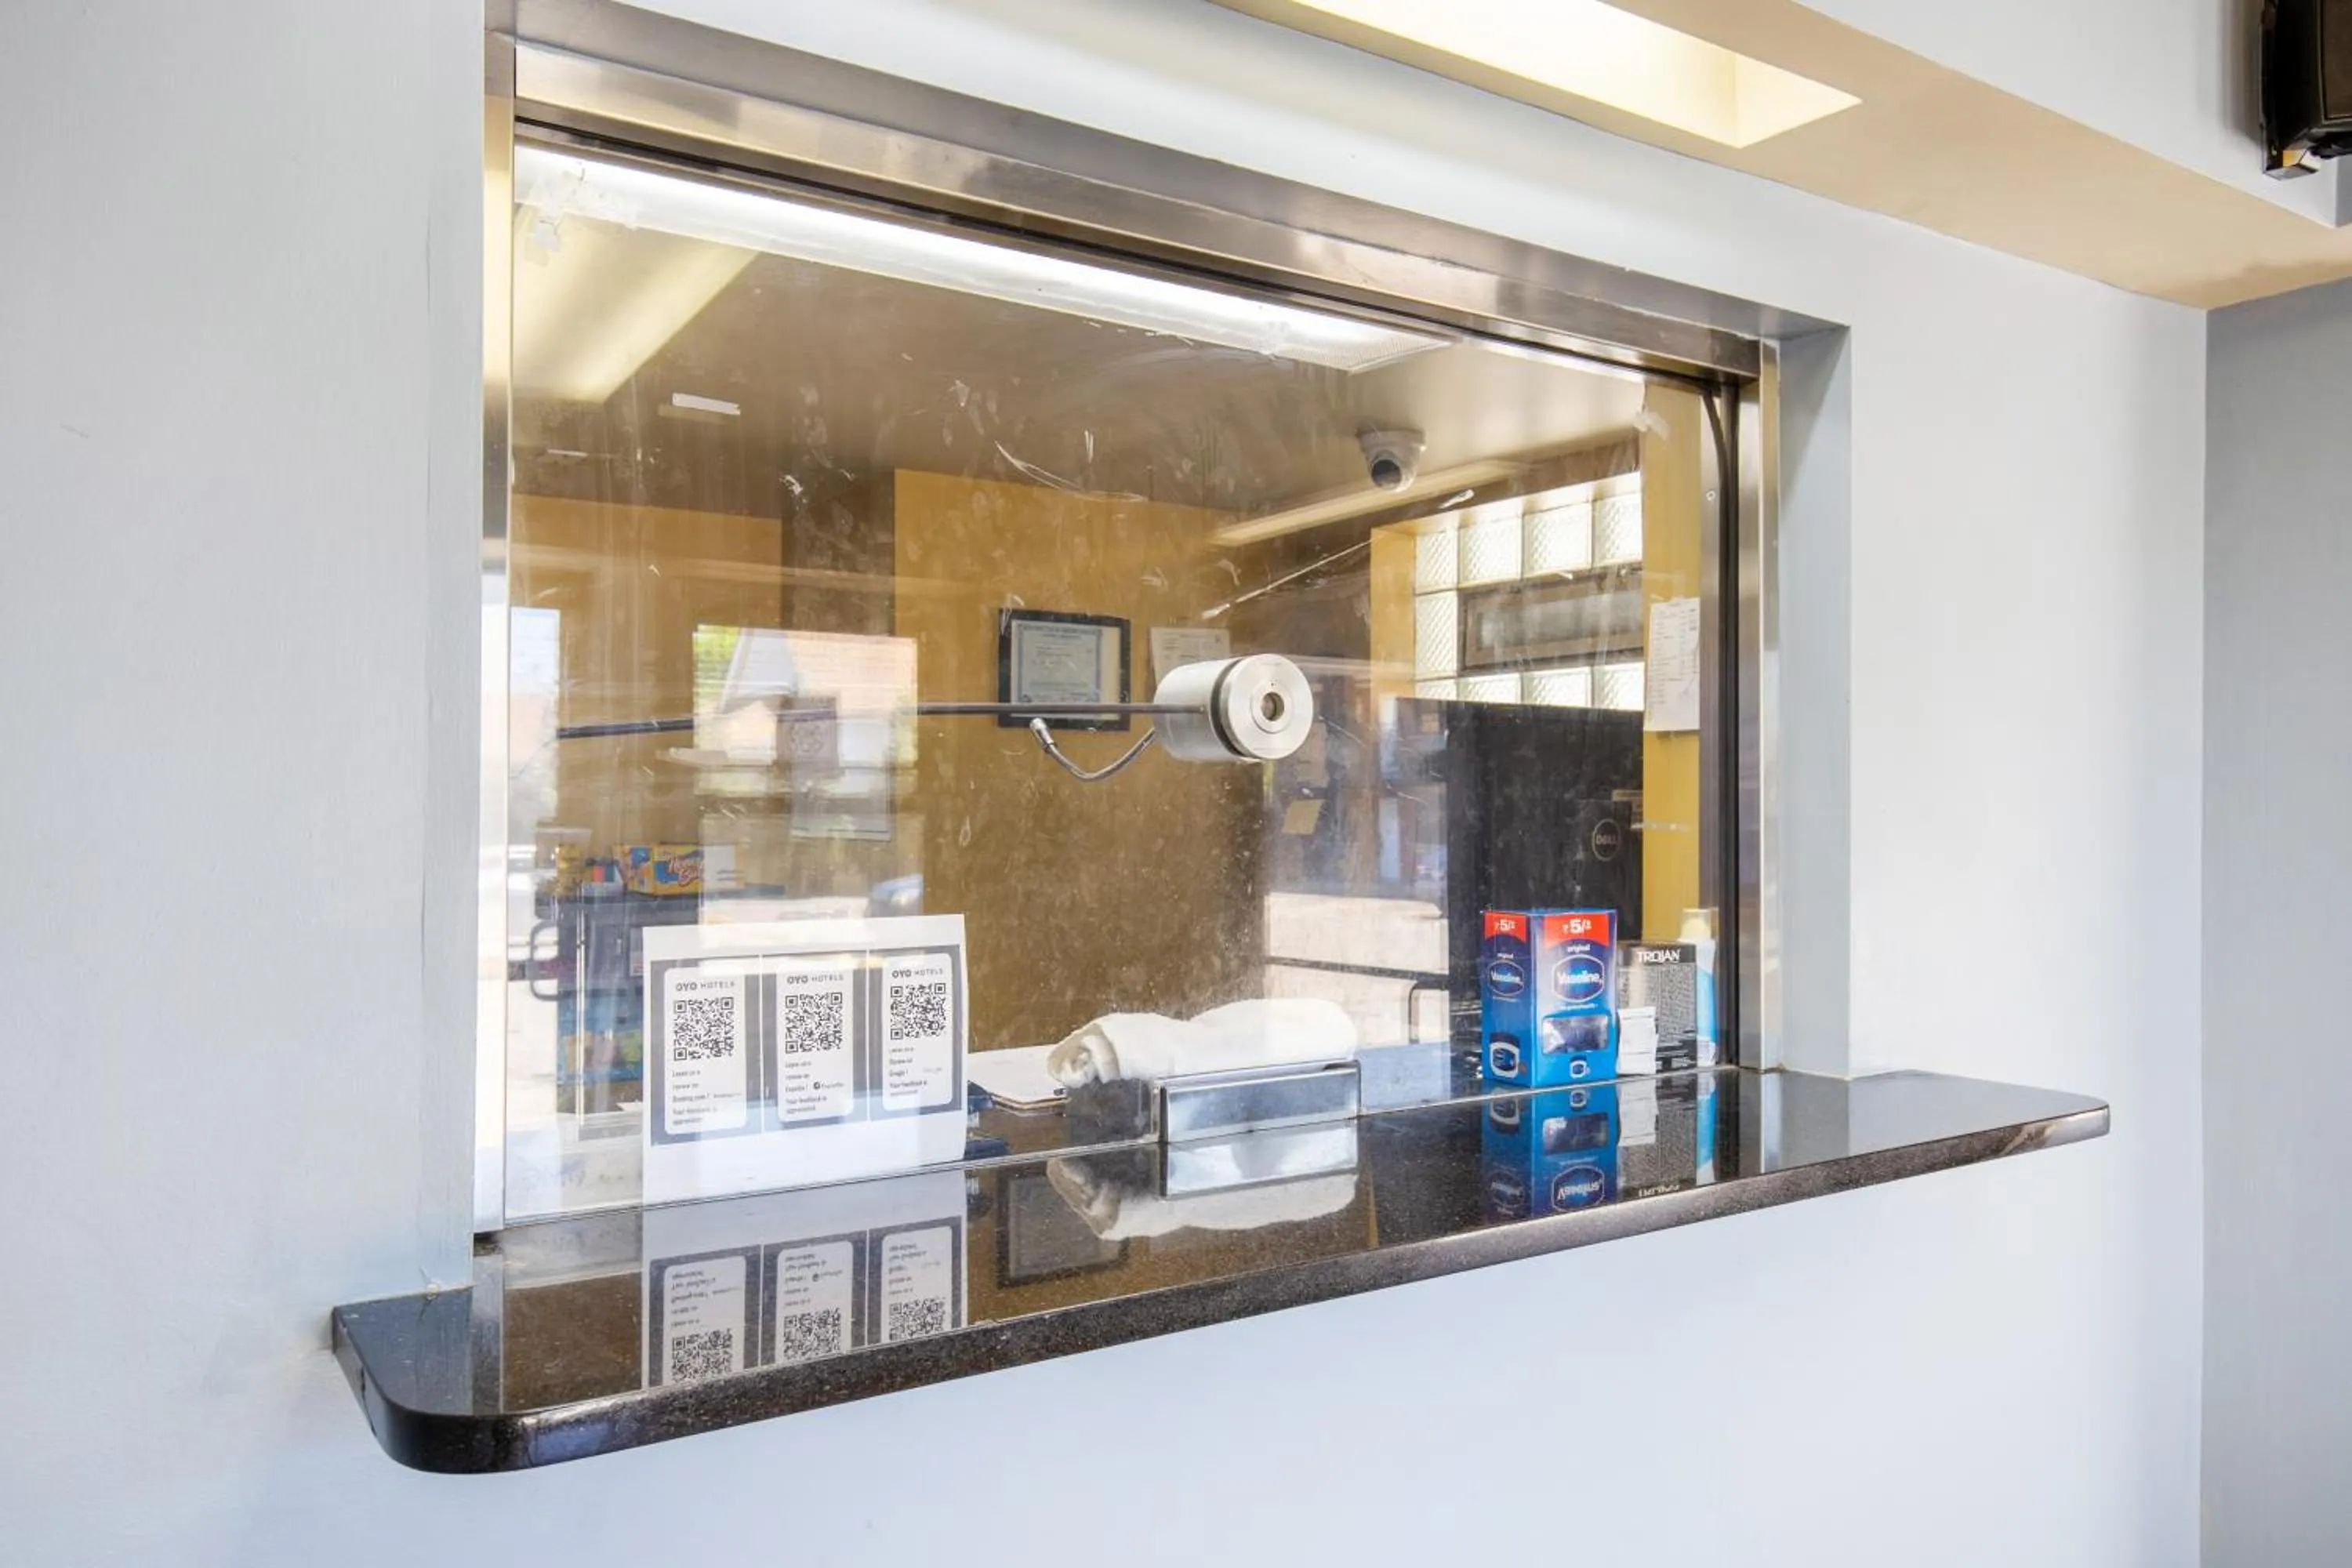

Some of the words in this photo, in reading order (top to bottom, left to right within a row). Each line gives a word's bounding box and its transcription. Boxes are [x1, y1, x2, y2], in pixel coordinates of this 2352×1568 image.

[1636, 949, 1681, 963] TROJAN
[891, 969, 912, 978] OYO
[914, 967, 944, 976] HOTELS
[786, 975, 808, 985] OYO
[811, 974, 844, 982] HOTELS
[676, 982, 698, 992] OYO
